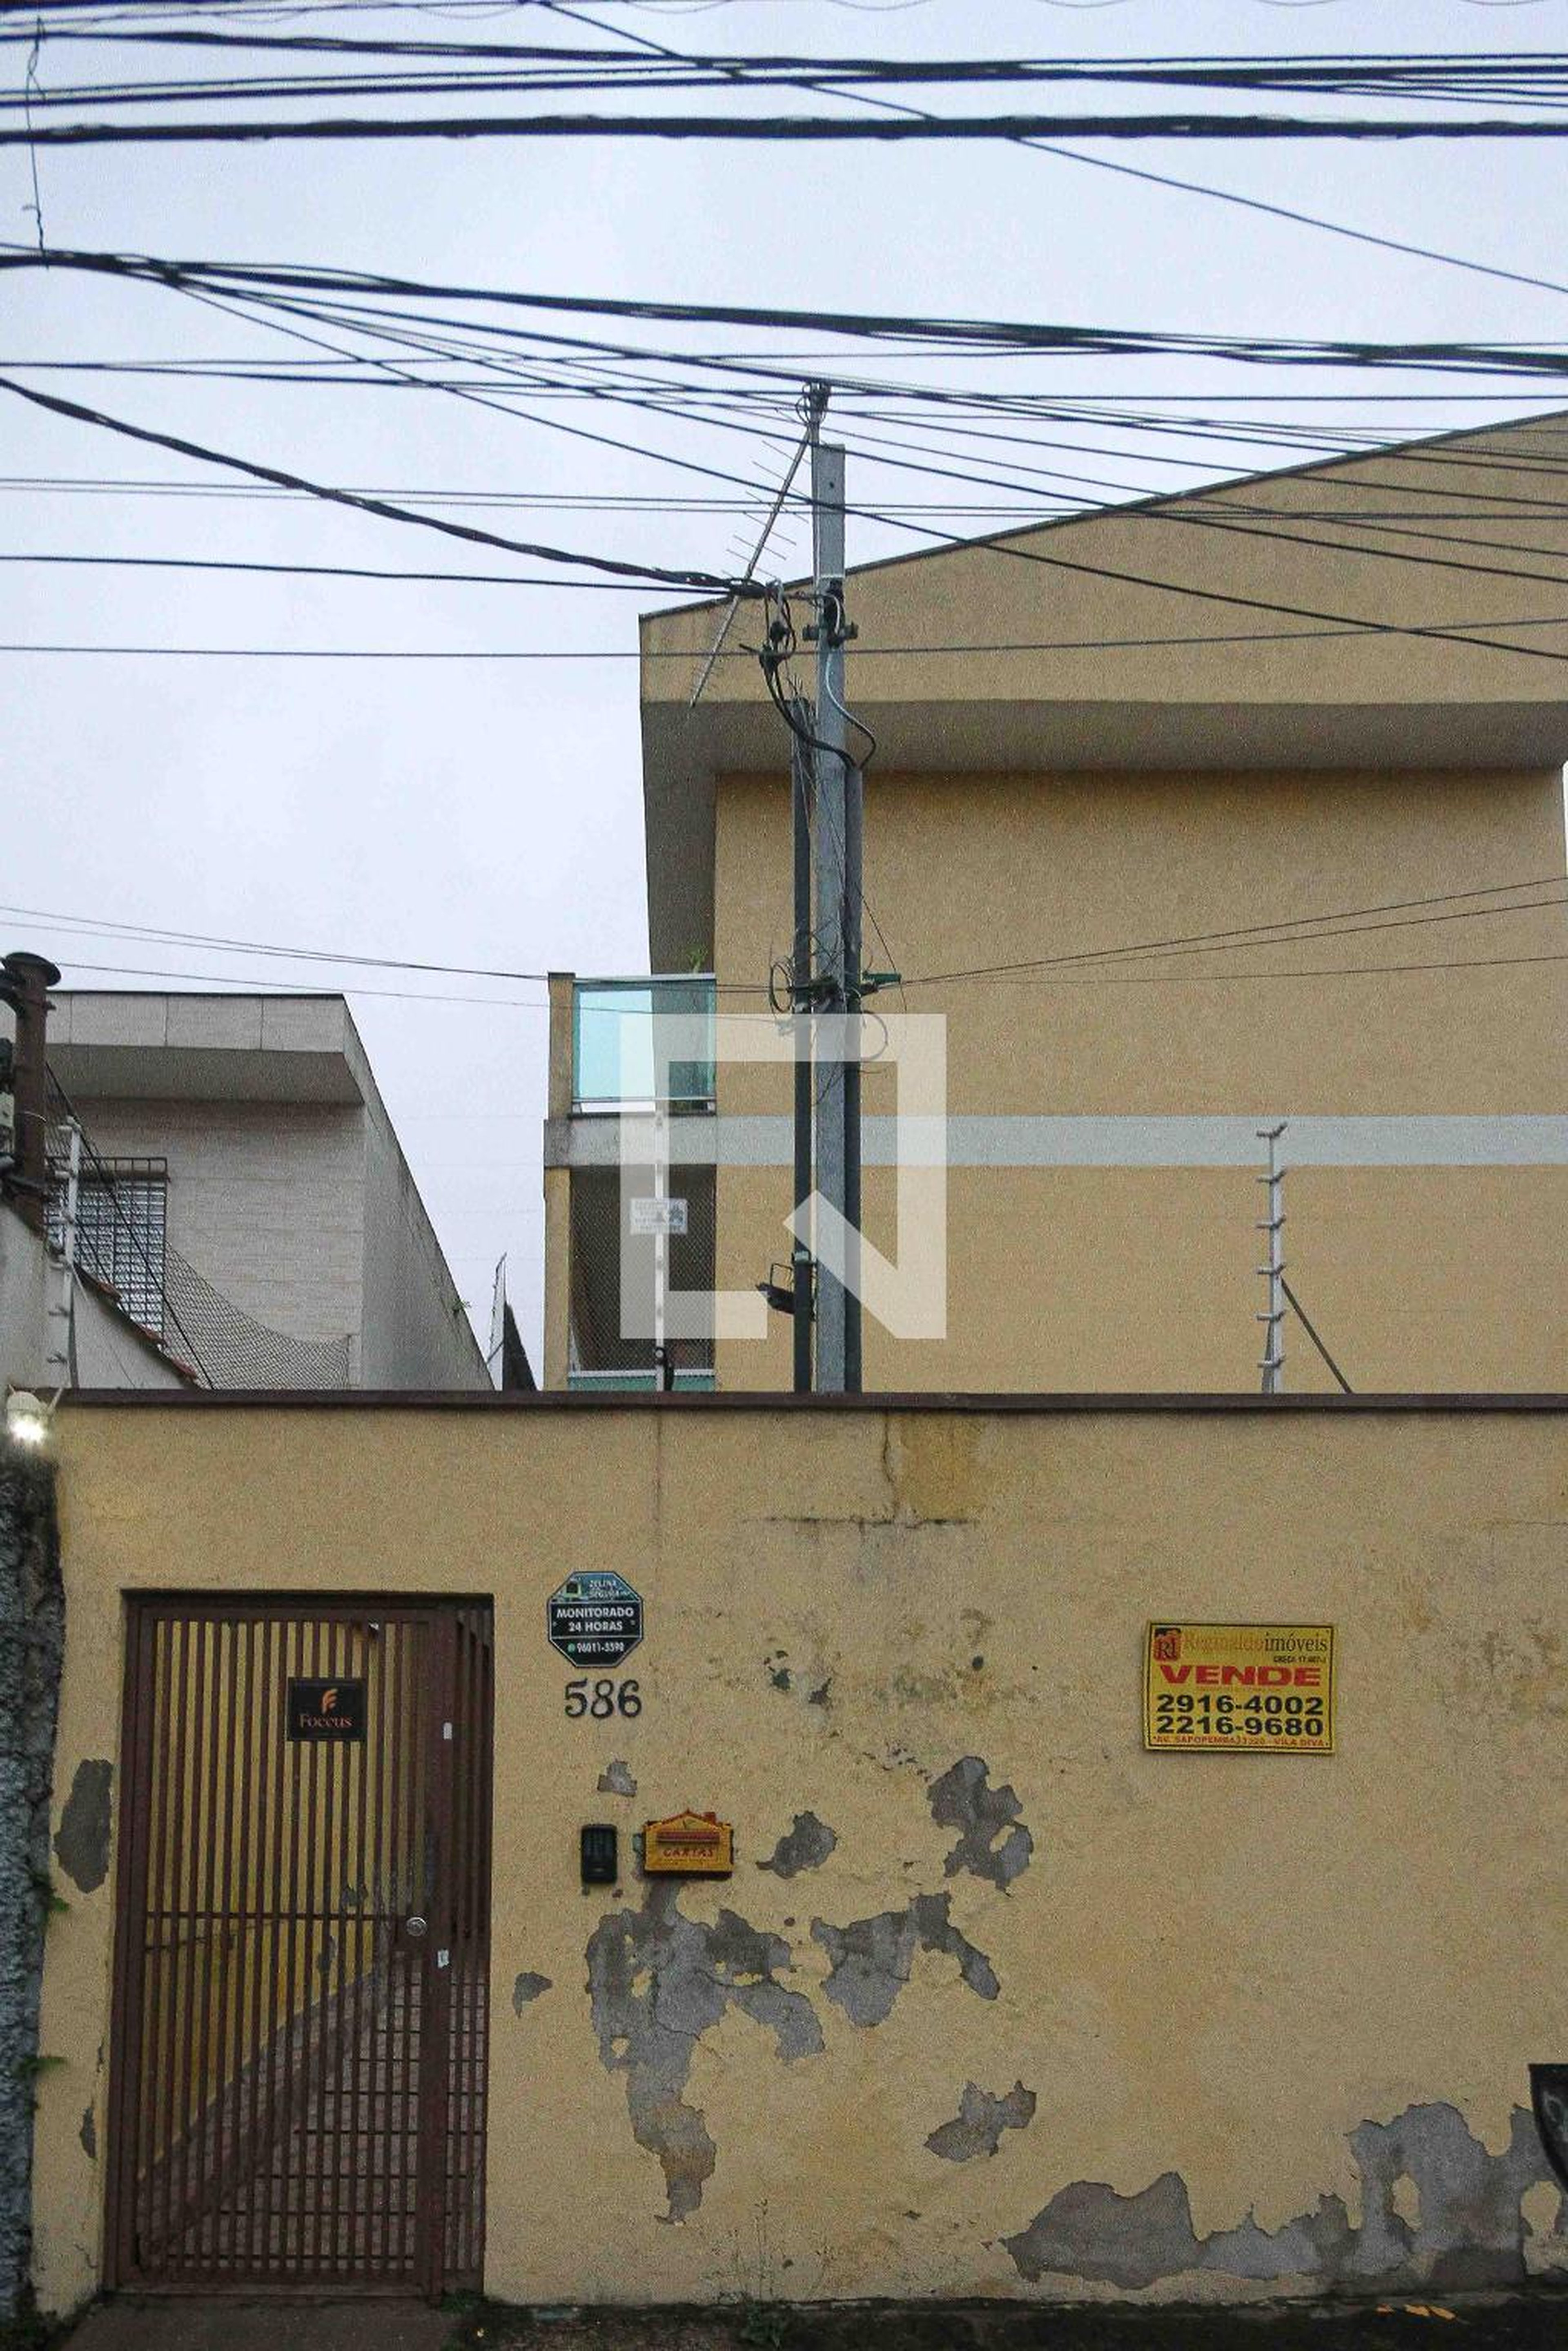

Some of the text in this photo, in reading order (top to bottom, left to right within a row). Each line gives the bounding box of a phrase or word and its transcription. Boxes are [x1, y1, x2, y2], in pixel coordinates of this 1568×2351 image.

[557, 1607, 634, 1618] MONITORADO
[569, 1621, 623, 1632] 24 HORAS
[1160, 1665, 1321, 1686] VENDE
[565, 1678, 641, 1718] 586
[1157, 1693, 1323, 1715] 2916-4002
[1156, 1715, 1323, 1736] 2216-9680
